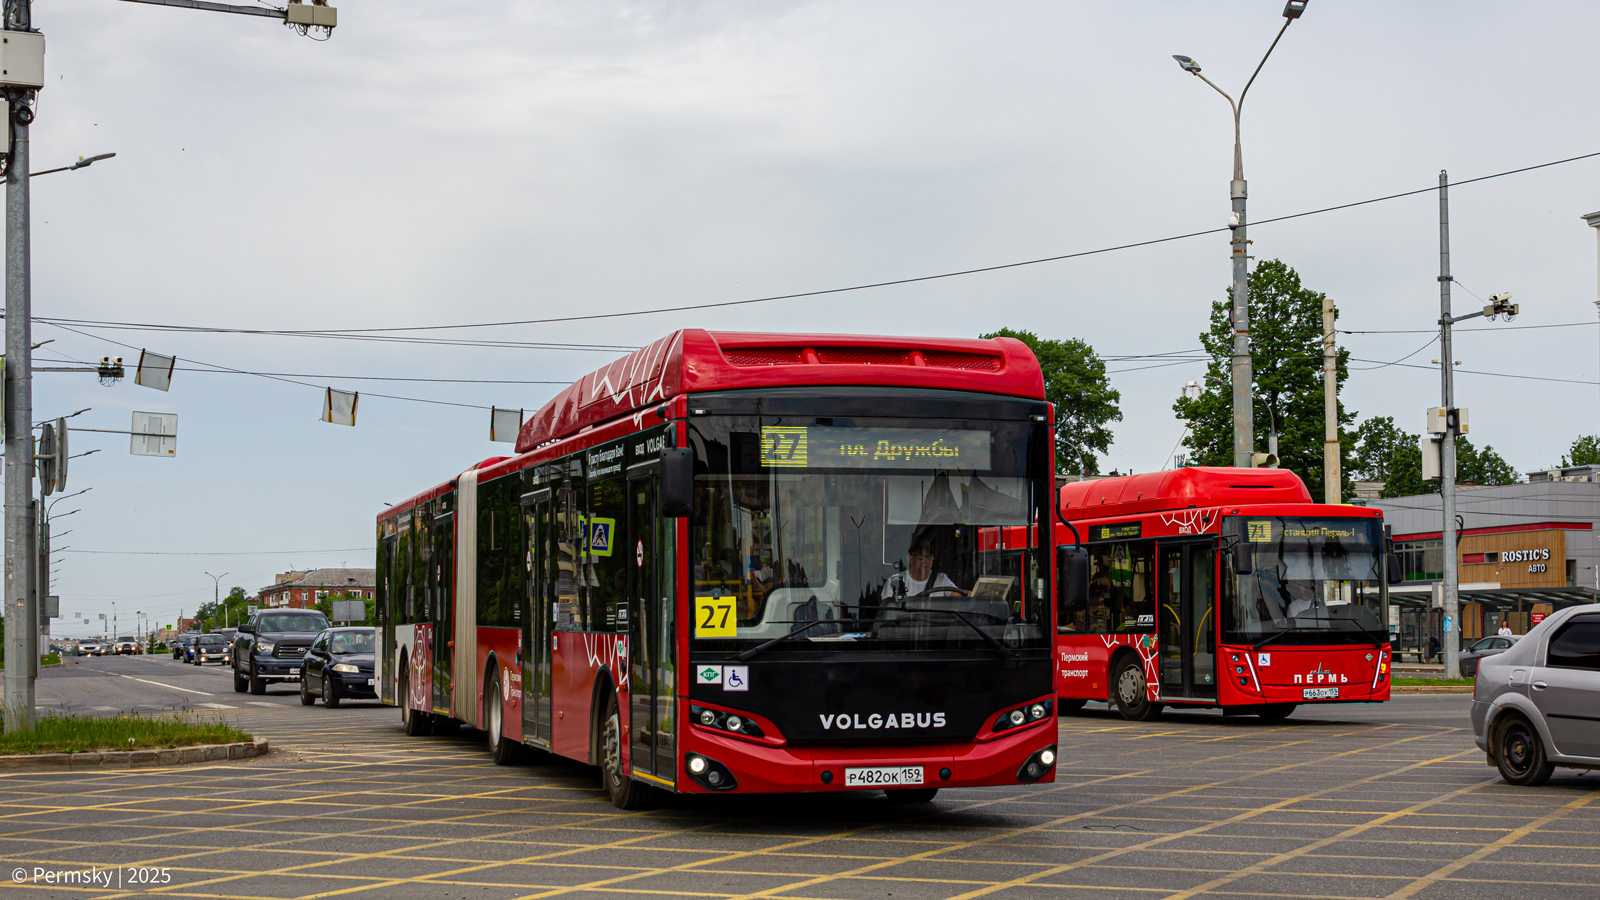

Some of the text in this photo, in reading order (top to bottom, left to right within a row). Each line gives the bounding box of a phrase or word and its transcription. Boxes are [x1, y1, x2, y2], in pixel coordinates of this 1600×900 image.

[765, 433, 801, 459] 27
[874, 439, 959, 460] Дружбы
[1284, 529, 1319, 540] станция
[1502, 549, 1550, 562] ROSTIC'S
[1528, 564, 1546, 573] АВТО
[701, 605, 731, 629] 27
[1061, 651, 1089, 665] Пермский
[1061, 669, 1089, 679] транспорт
[1294, 673, 1348, 684] ПЕРМЬ
[819, 712, 947, 729] VOLGABUS
[901, 768, 920, 779] 159
